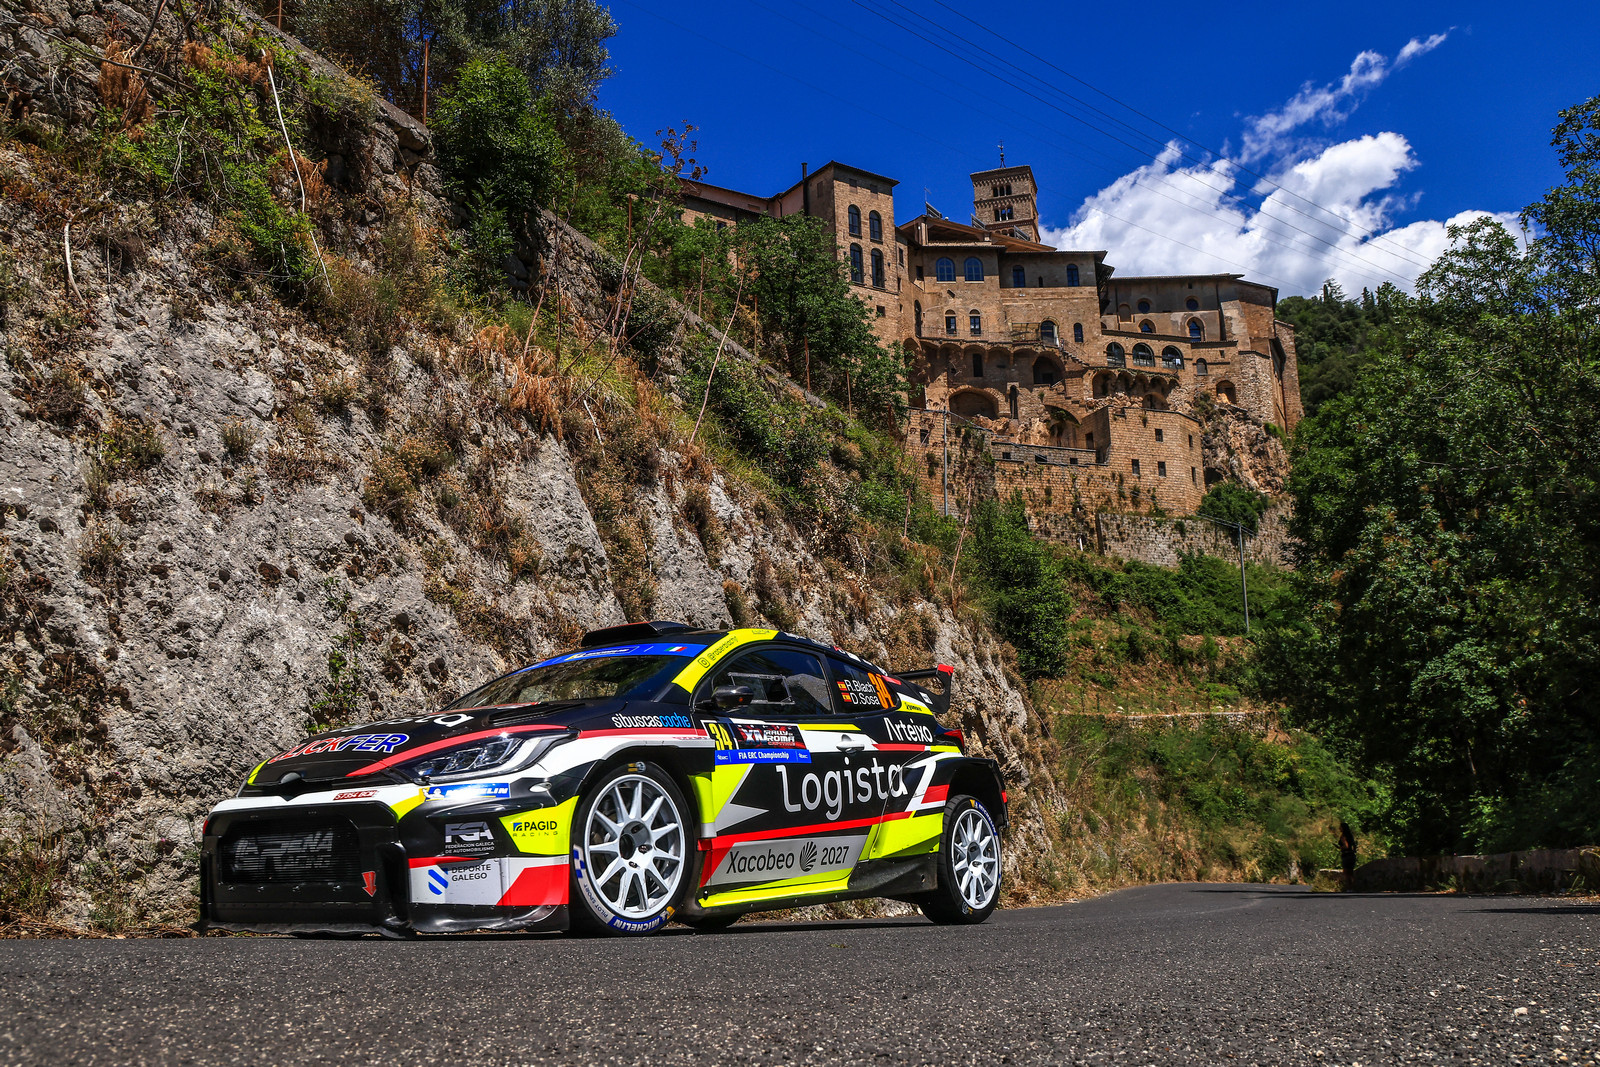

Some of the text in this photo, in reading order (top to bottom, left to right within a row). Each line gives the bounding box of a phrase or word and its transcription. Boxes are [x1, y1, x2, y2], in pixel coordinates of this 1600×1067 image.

[844, 679, 876, 693] R.Blach
[867, 672, 897, 709] 34
[850, 692, 880, 706] D.Sosa
[611, 712, 691, 728] sibuscascoche
[708, 723, 733, 750] 34
[883, 717, 933, 743] Arteixo
[738, 751, 790, 760] FIA ERC Championship
[775, 756, 910, 821] logista
[524, 820, 558, 831] PAGID
[726, 848, 795, 874] Xacobeo
[820, 845, 850, 865] 2027
[451, 864, 492, 874] DEPORTE
[451, 872, 488, 882] GALEGO
[583, 884, 609, 918] PILOT SPORT
[613, 915, 661, 932] MICHELIN
